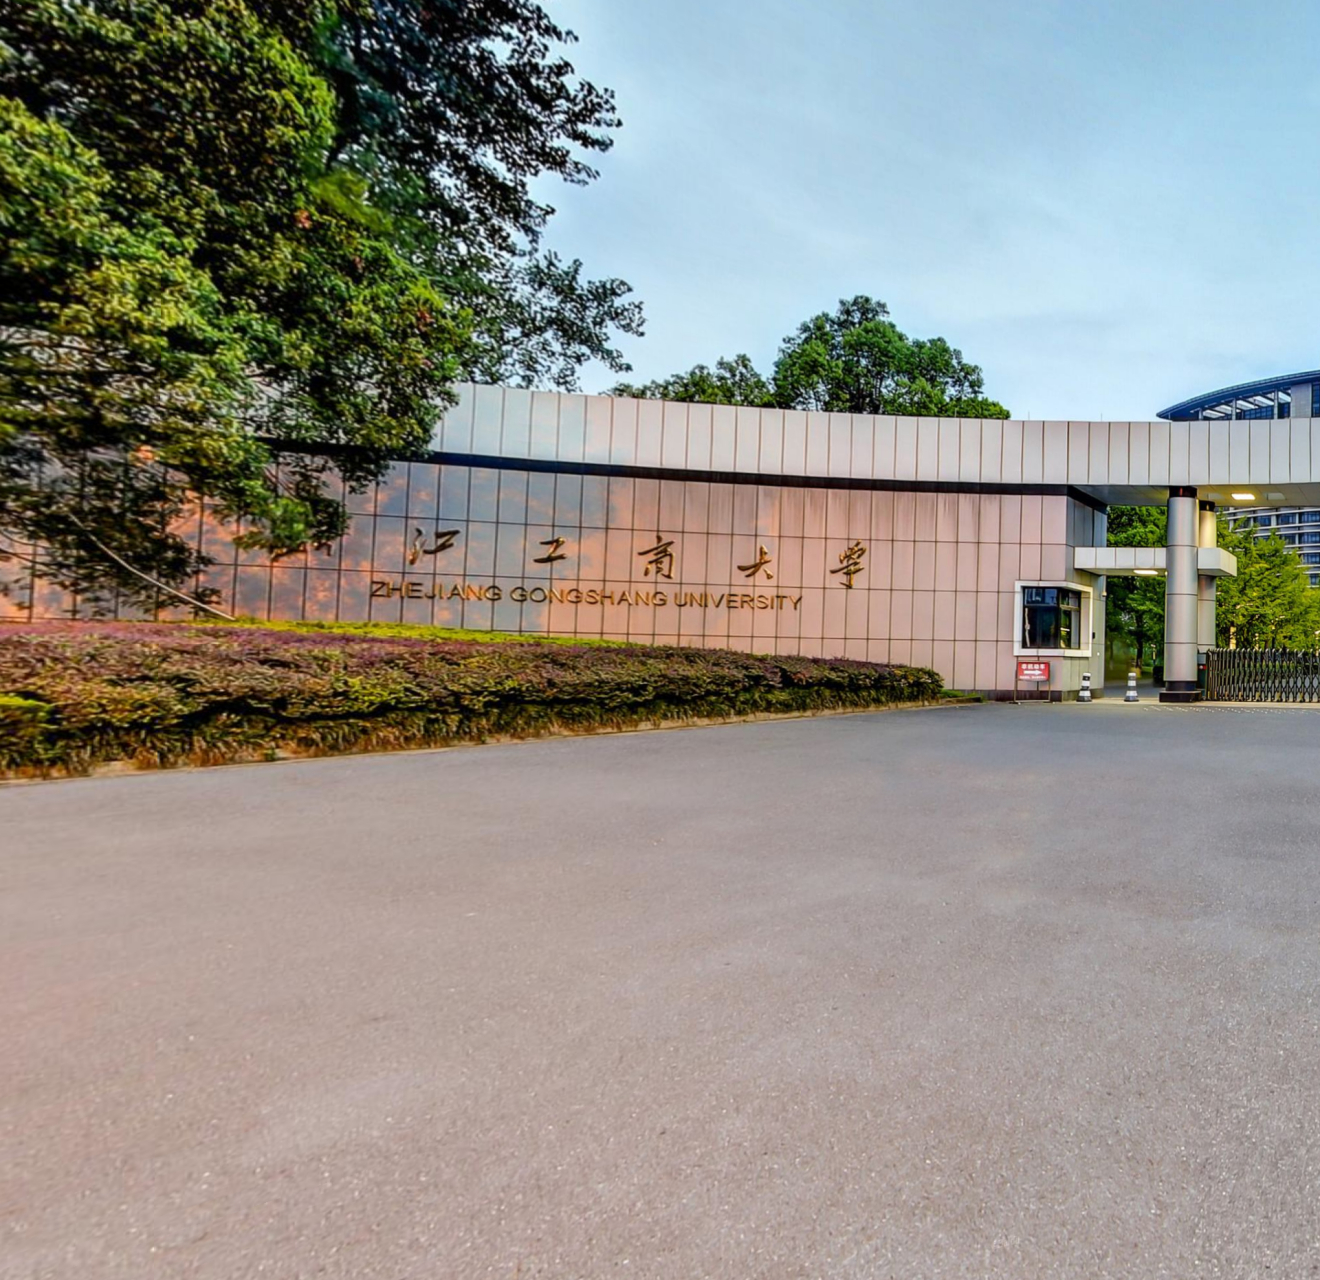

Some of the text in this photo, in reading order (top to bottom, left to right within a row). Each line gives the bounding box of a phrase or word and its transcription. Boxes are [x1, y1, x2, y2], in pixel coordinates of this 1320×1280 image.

[370, 580, 803, 611] ZHEJIANG GONGSHANG UNIVERSITY
